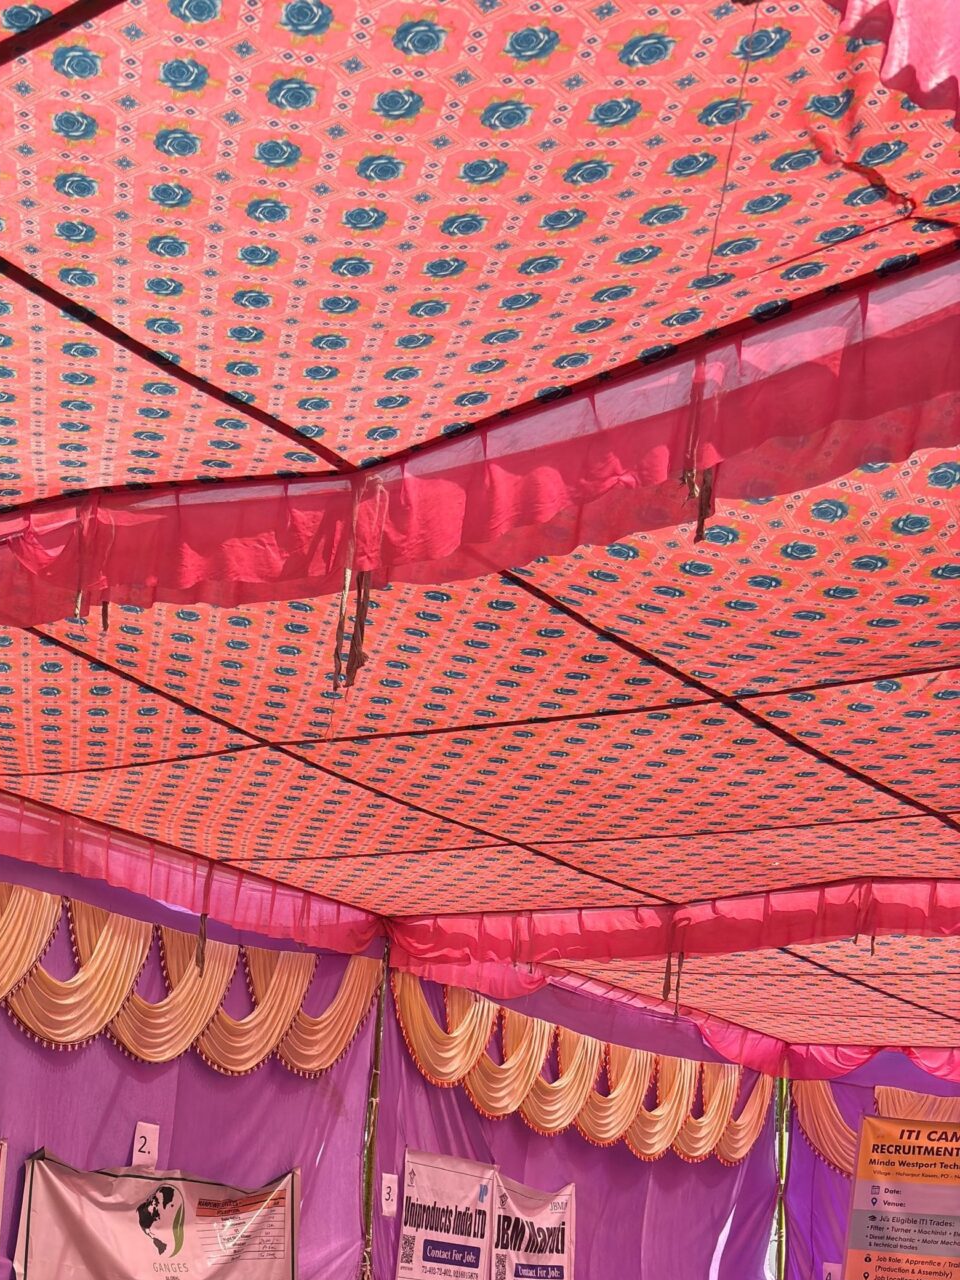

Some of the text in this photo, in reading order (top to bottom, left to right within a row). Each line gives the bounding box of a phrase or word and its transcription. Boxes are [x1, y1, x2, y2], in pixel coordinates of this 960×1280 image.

[899, 1129, 921, 1141] ITI
[138, 1136, 151, 1155] 2.
[871, 1144, 960, 1157] RECRUITMENT
[868, 1158, 960, 1170] Minda Westport Tech
[384, 1186, 394, 1202] 3.
[884, 1187, 902, 1195] Date:
[882, 1199, 906, 1208] Venue:
[403, 1196, 487, 1239] Uniproducts India LTD
[891, 1216, 918, 1225] Eligible
[929, 1219, 956, 1227] Trades:
[494, 1214, 566, 1255] JBM Maruti
[891, 1226, 912, 1234] Turner
[886, 1235, 916, 1243] Mechanic
[426, 1245, 451, 1260] Contact
[451, 1249, 462, 1261] For
[152, 1262, 189, 1273] GANGES
[904, 1257, 941, 1267] Apprentice
[517, 1265, 536, 1277] Contact
[537, 1266, 547, 1278] For
[874, 1265, 910, 1274] (Production
[916, 1269, 953, 1279] Assembly)
